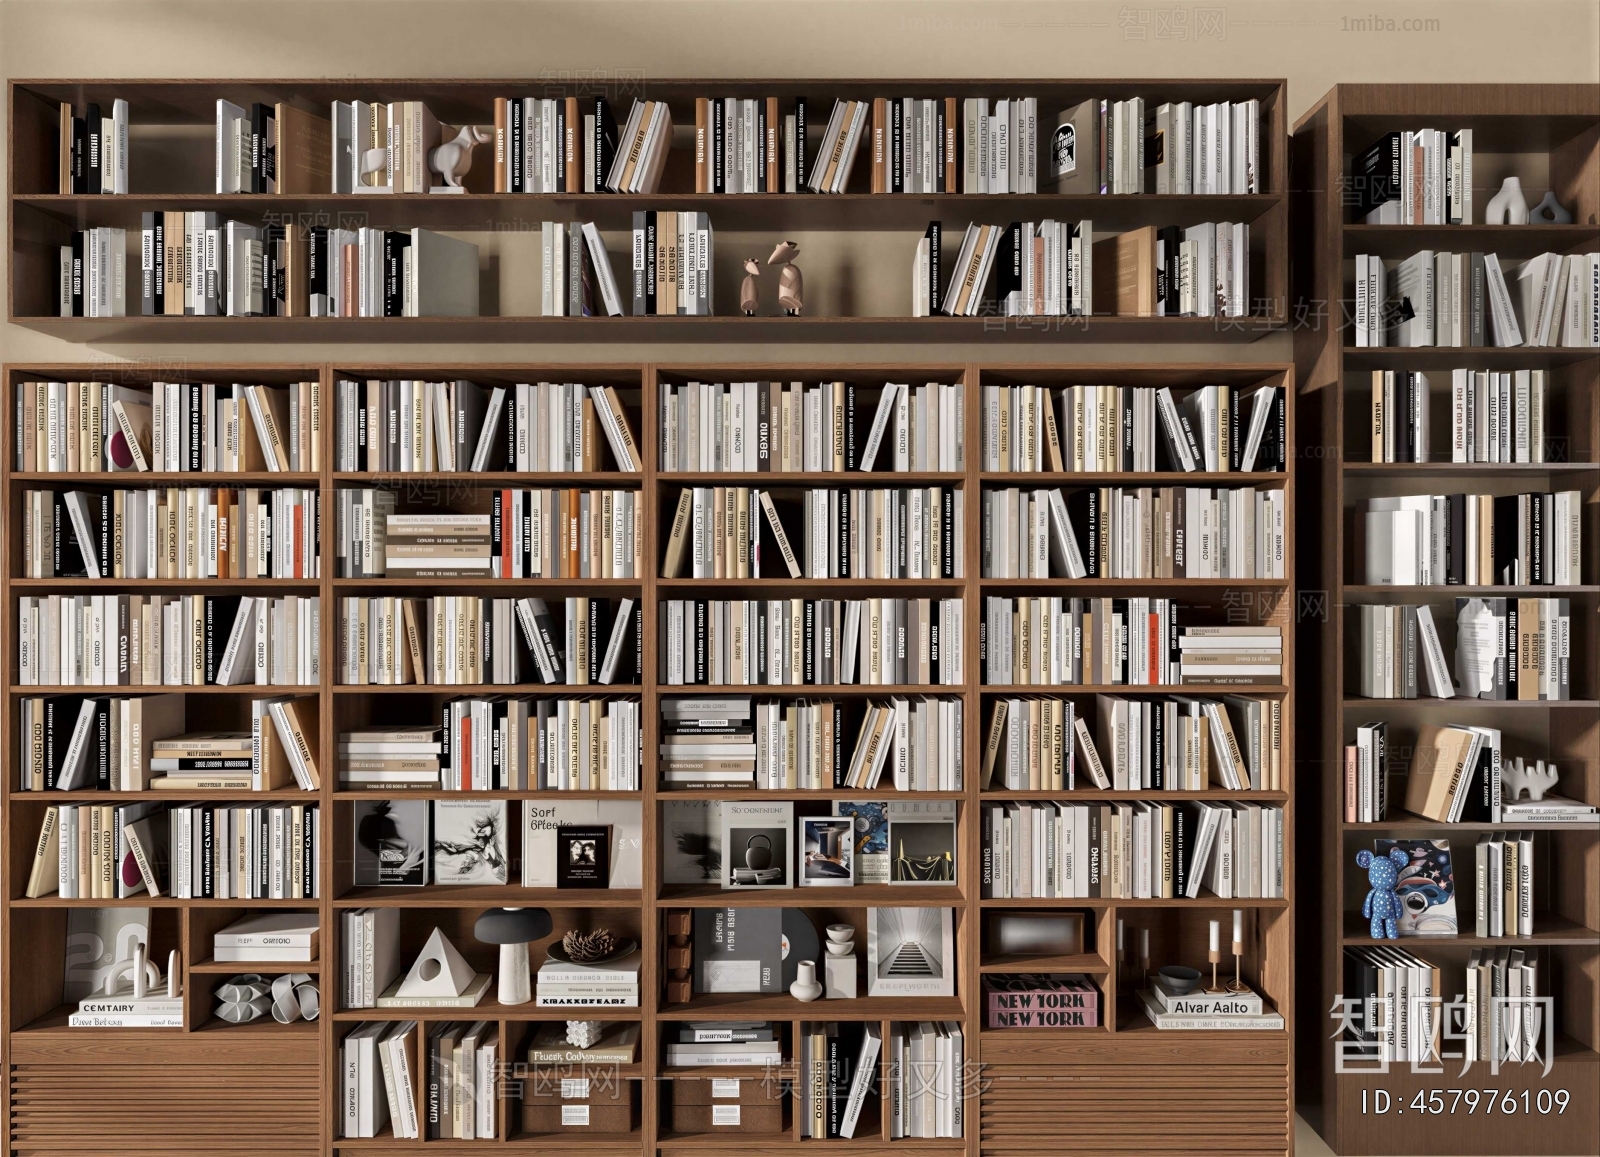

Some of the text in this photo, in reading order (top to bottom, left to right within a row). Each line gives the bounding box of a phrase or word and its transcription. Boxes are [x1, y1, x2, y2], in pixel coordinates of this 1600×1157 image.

[997, 993, 1085, 1009] NEW YORK
[1174, 1001, 1248, 1014] Alvar Aalto
[997, 1010, 1085, 1026] NEW YORK
